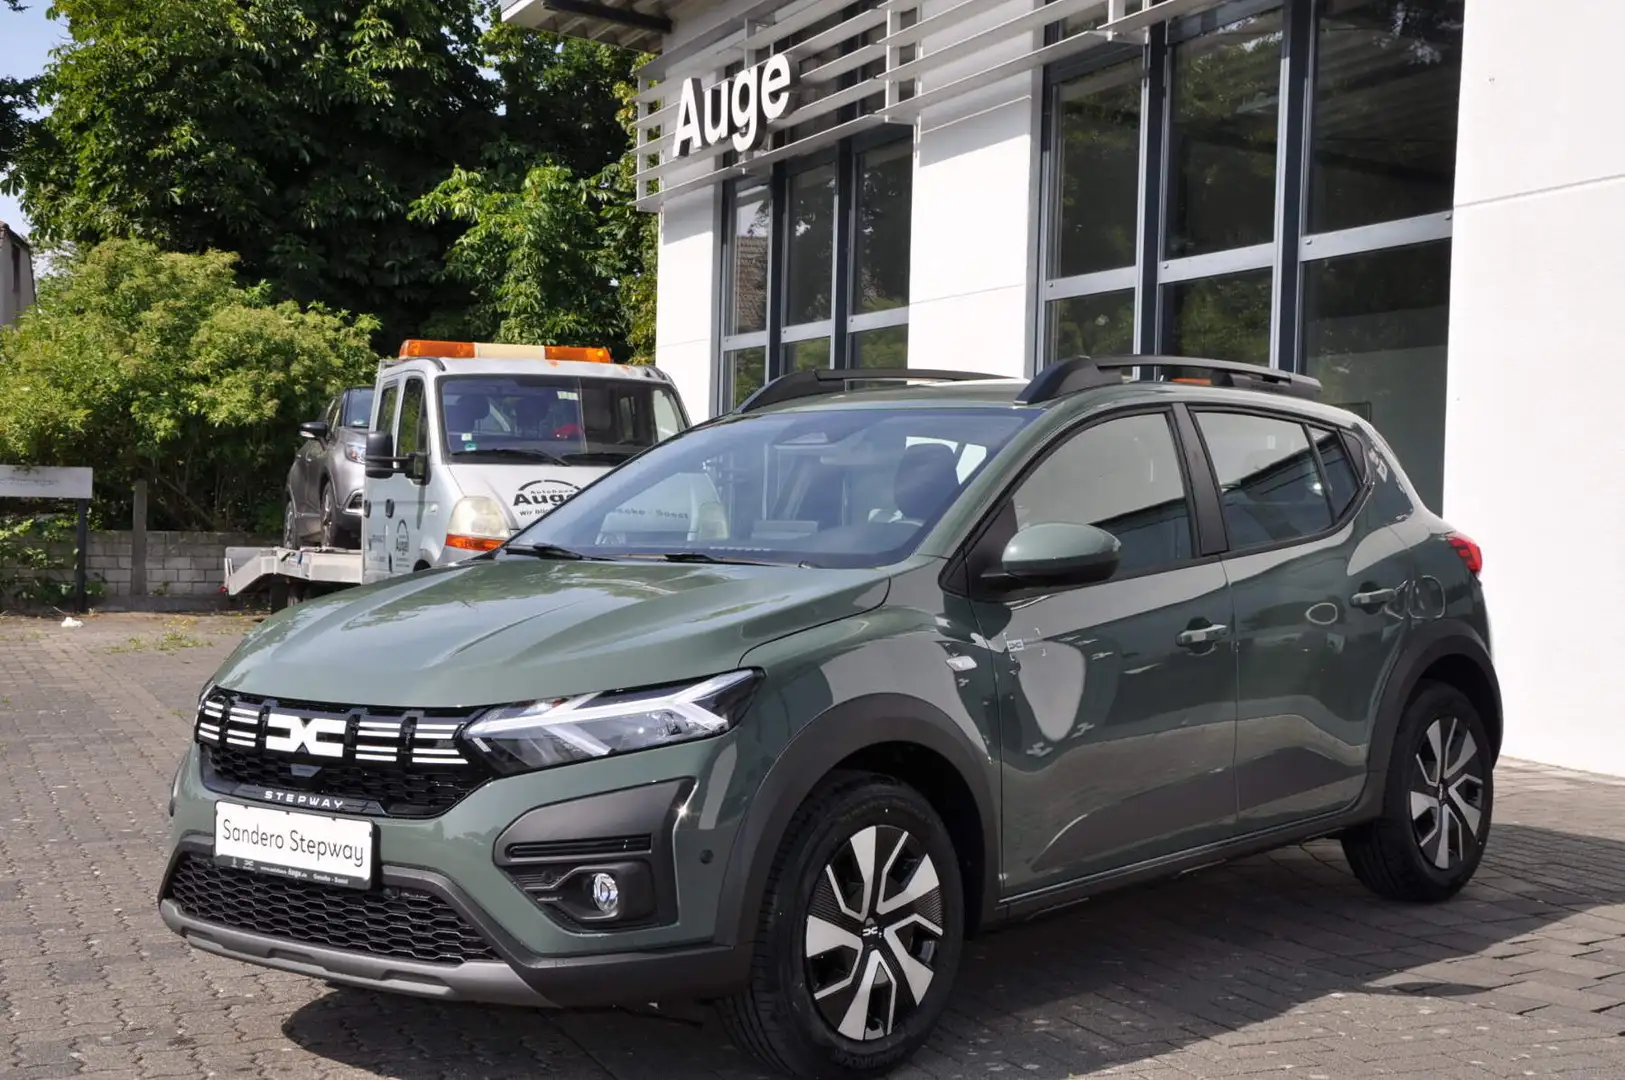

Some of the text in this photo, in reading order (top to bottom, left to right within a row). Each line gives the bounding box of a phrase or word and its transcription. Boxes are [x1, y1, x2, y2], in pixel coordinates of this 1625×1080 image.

[672, 54, 791, 157] Auge
[264, 790, 344, 808] STEPWAY
[223, 818, 364, 867] Sandero Stepway
